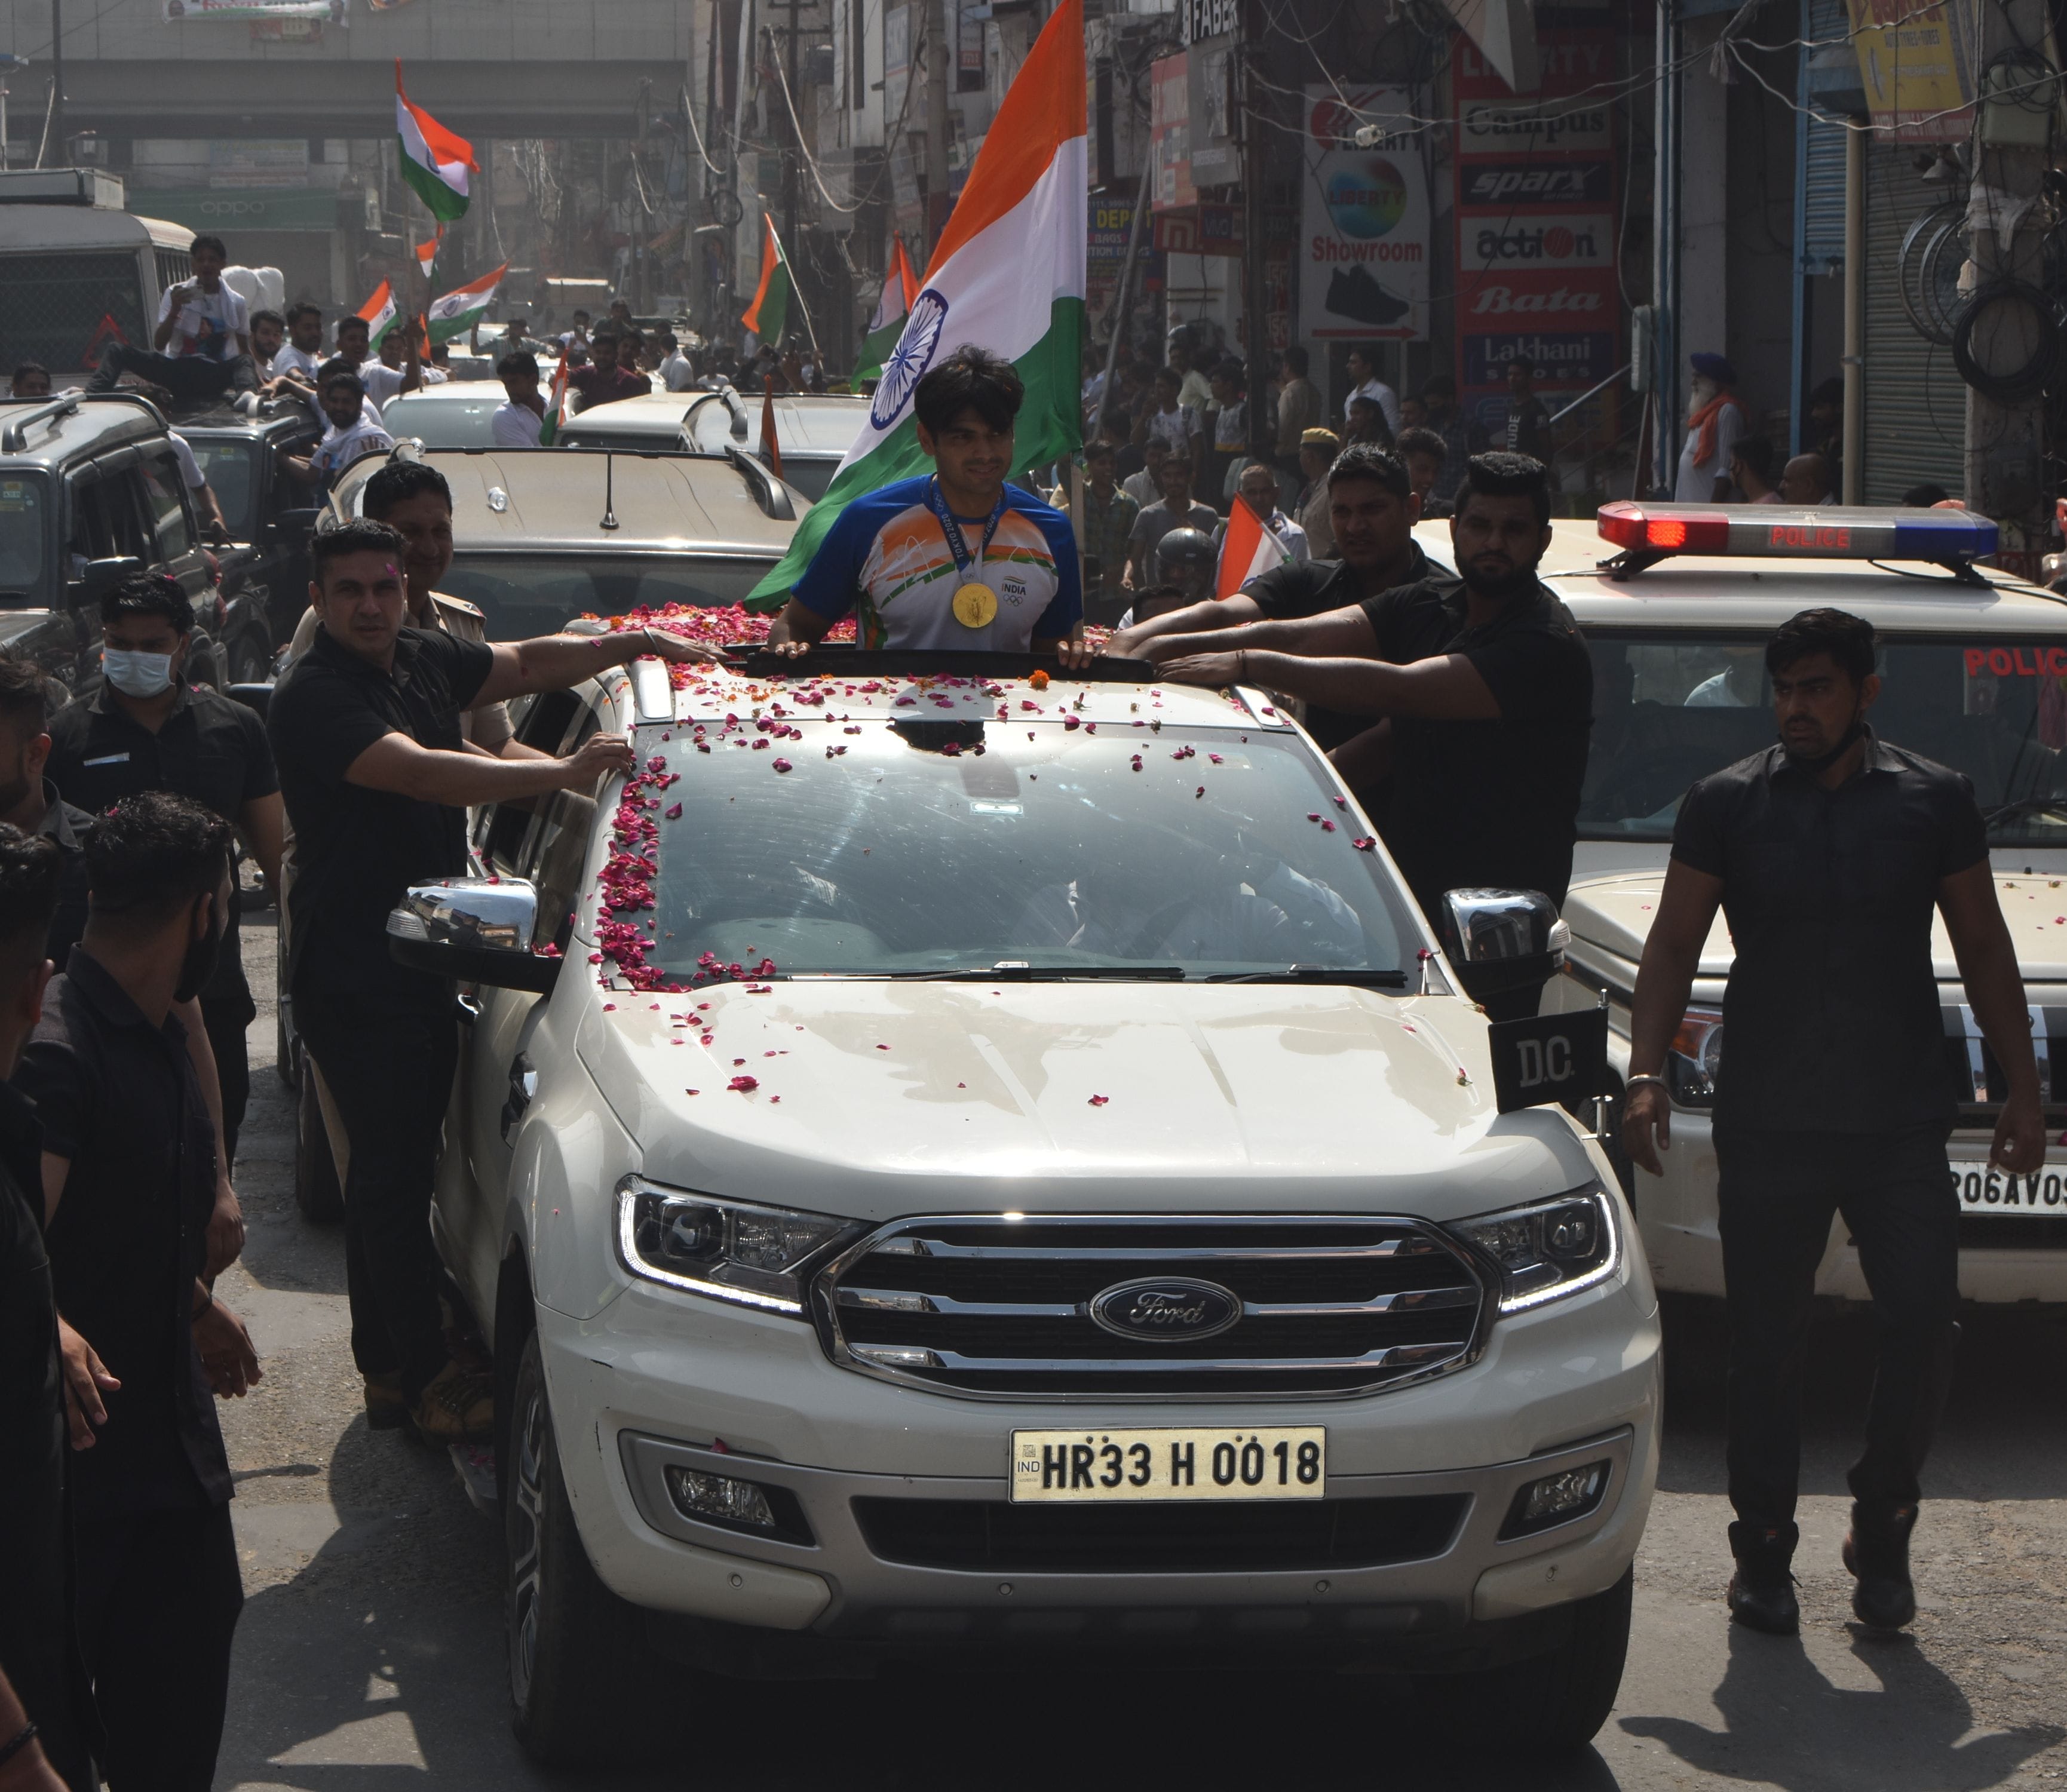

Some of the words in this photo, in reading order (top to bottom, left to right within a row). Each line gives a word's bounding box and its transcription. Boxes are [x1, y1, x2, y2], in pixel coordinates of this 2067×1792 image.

[1462, 44, 1603, 76] LIRTY
[1466, 106, 1605, 143] Campus
[1343, 131, 1420, 151] LERTY
[1471, 166, 1600, 199] sparx
[201, 201, 265, 216] oppo
[1329, 190, 1403, 205] LIBERTY
[1312, 236, 1422, 262] Showroom
[1477, 226, 1597, 259] action
[1471, 285, 1604, 314] Bata
[1485, 337, 1590, 362] Lakhani
[942, 514, 954, 532] 2020
[949, 533, 964, 559] TOKYO
[1771, 526, 1850, 547] POLICE
[1001, 583, 1026, 595] INDIA
[1950, 1171, 2067, 1205] 06AV0
[1129, 1292, 1206, 1324] Ford
[1017, 1461, 1040, 1472] IND
[1043, 1444, 1152, 1489] HR33
[1171, 1442, 1194, 1486] H
[1213, 1441, 1320, 1486] 0018
